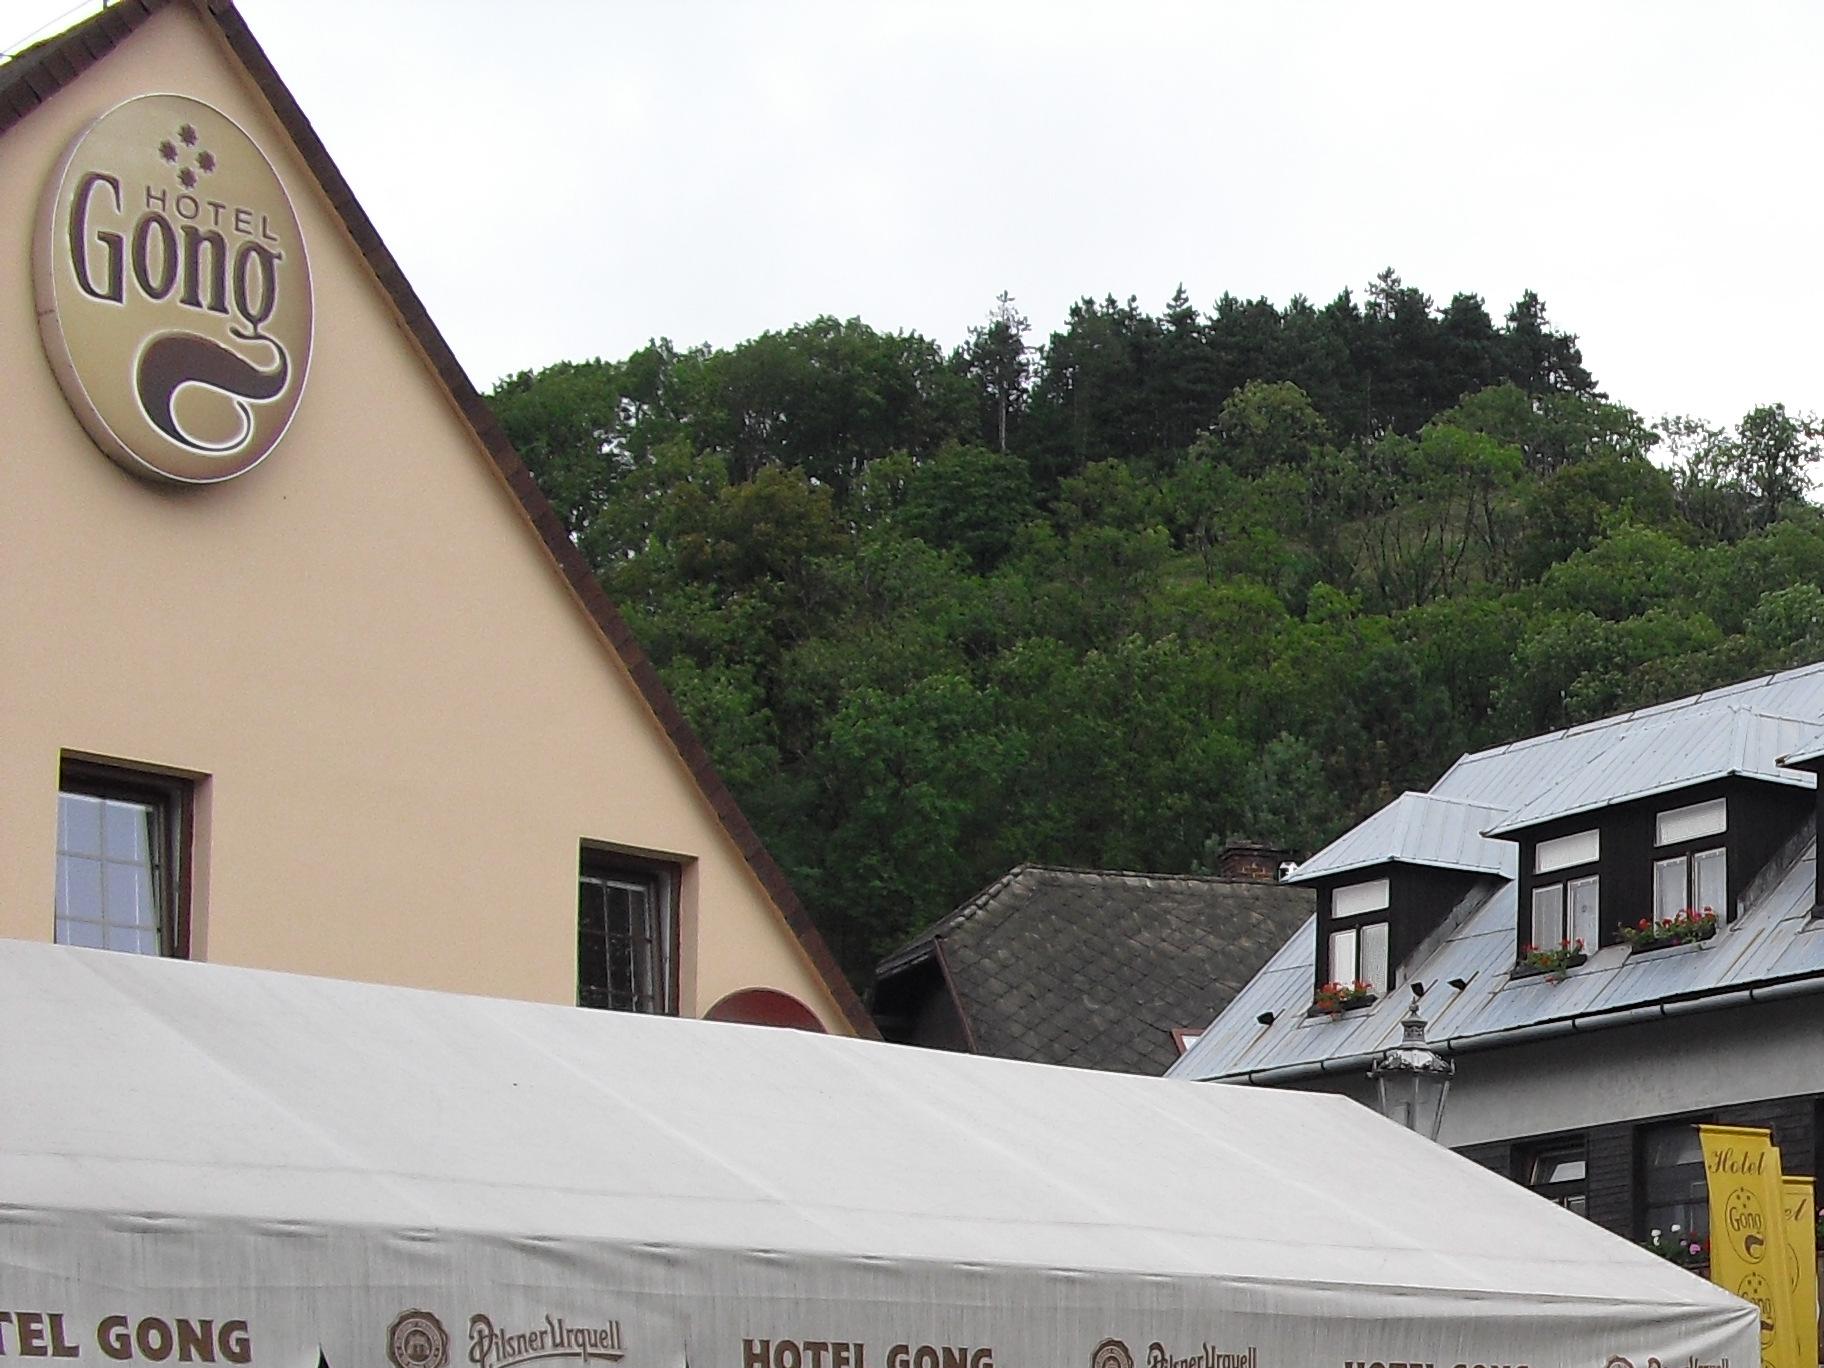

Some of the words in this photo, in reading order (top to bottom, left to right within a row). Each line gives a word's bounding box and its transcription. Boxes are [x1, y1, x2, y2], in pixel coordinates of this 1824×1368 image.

[144, 184, 281, 241] HOTEL
[68, 170, 283, 340] Gong
[1708, 1147, 1766, 1176] Hotel
[97, 1315, 253, 1364] GONG
[545, 1313, 622, 1362] Urquell
